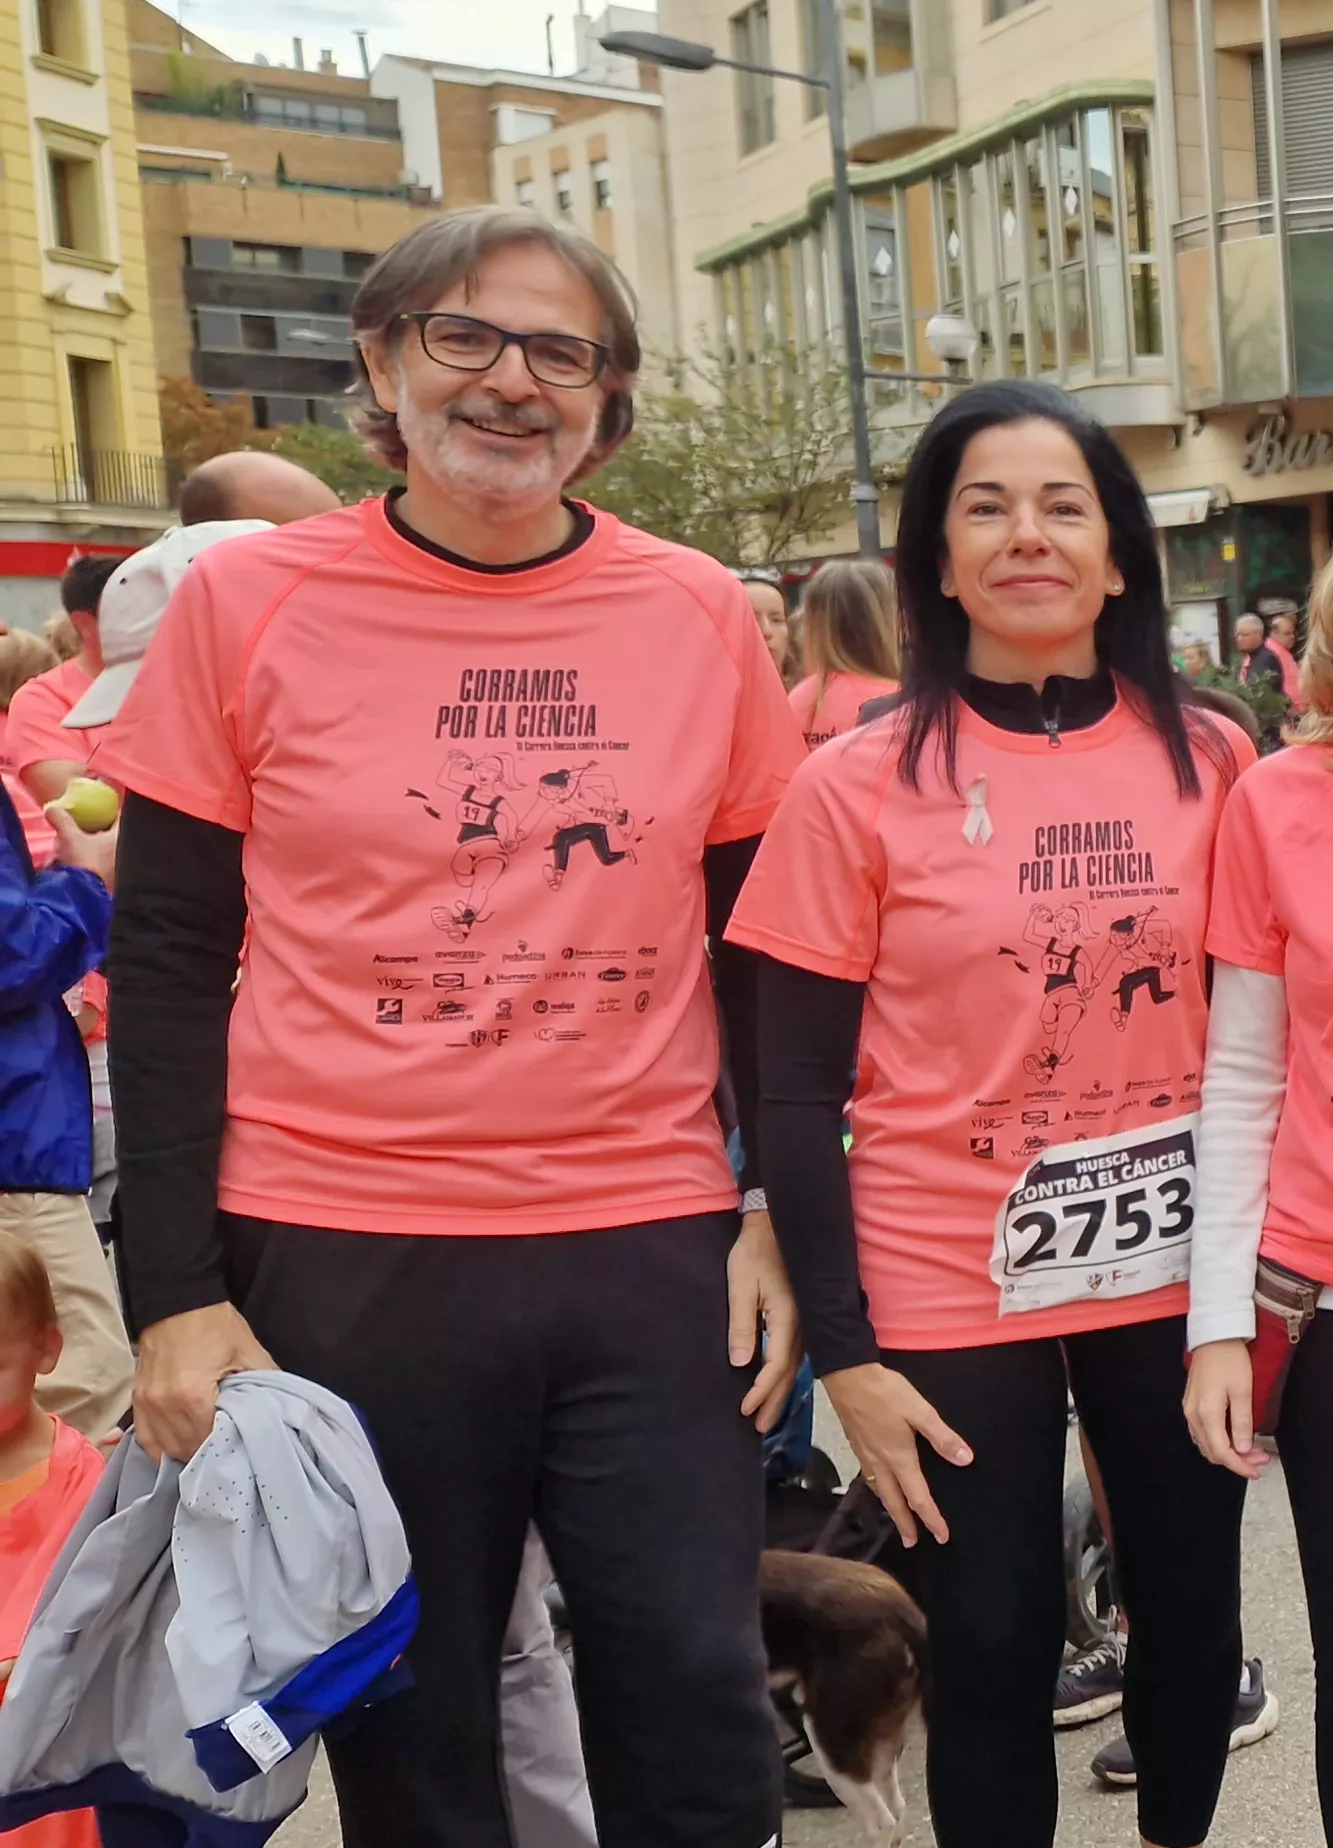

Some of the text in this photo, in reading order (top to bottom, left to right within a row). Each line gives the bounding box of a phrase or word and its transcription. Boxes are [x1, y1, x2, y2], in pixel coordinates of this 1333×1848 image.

[459, 668, 579, 703] CORRAMOS
[435, 704, 597, 739] POR LA CIENCIA
[463, 805, 481, 823] 19
[1035, 820, 1134, 858] CORRAMOS
[1018, 851, 1154, 895] POR LA CIENCIA
[545, 970, 586, 981] URBAN
[1047, 957, 1062, 972] 19
[1014, 1149, 1187, 1206] CONTRA EL CÁNCER
[1075, 1151, 1131, 1175] HUESCA
[1011, 1176, 1195, 1269] 2753
